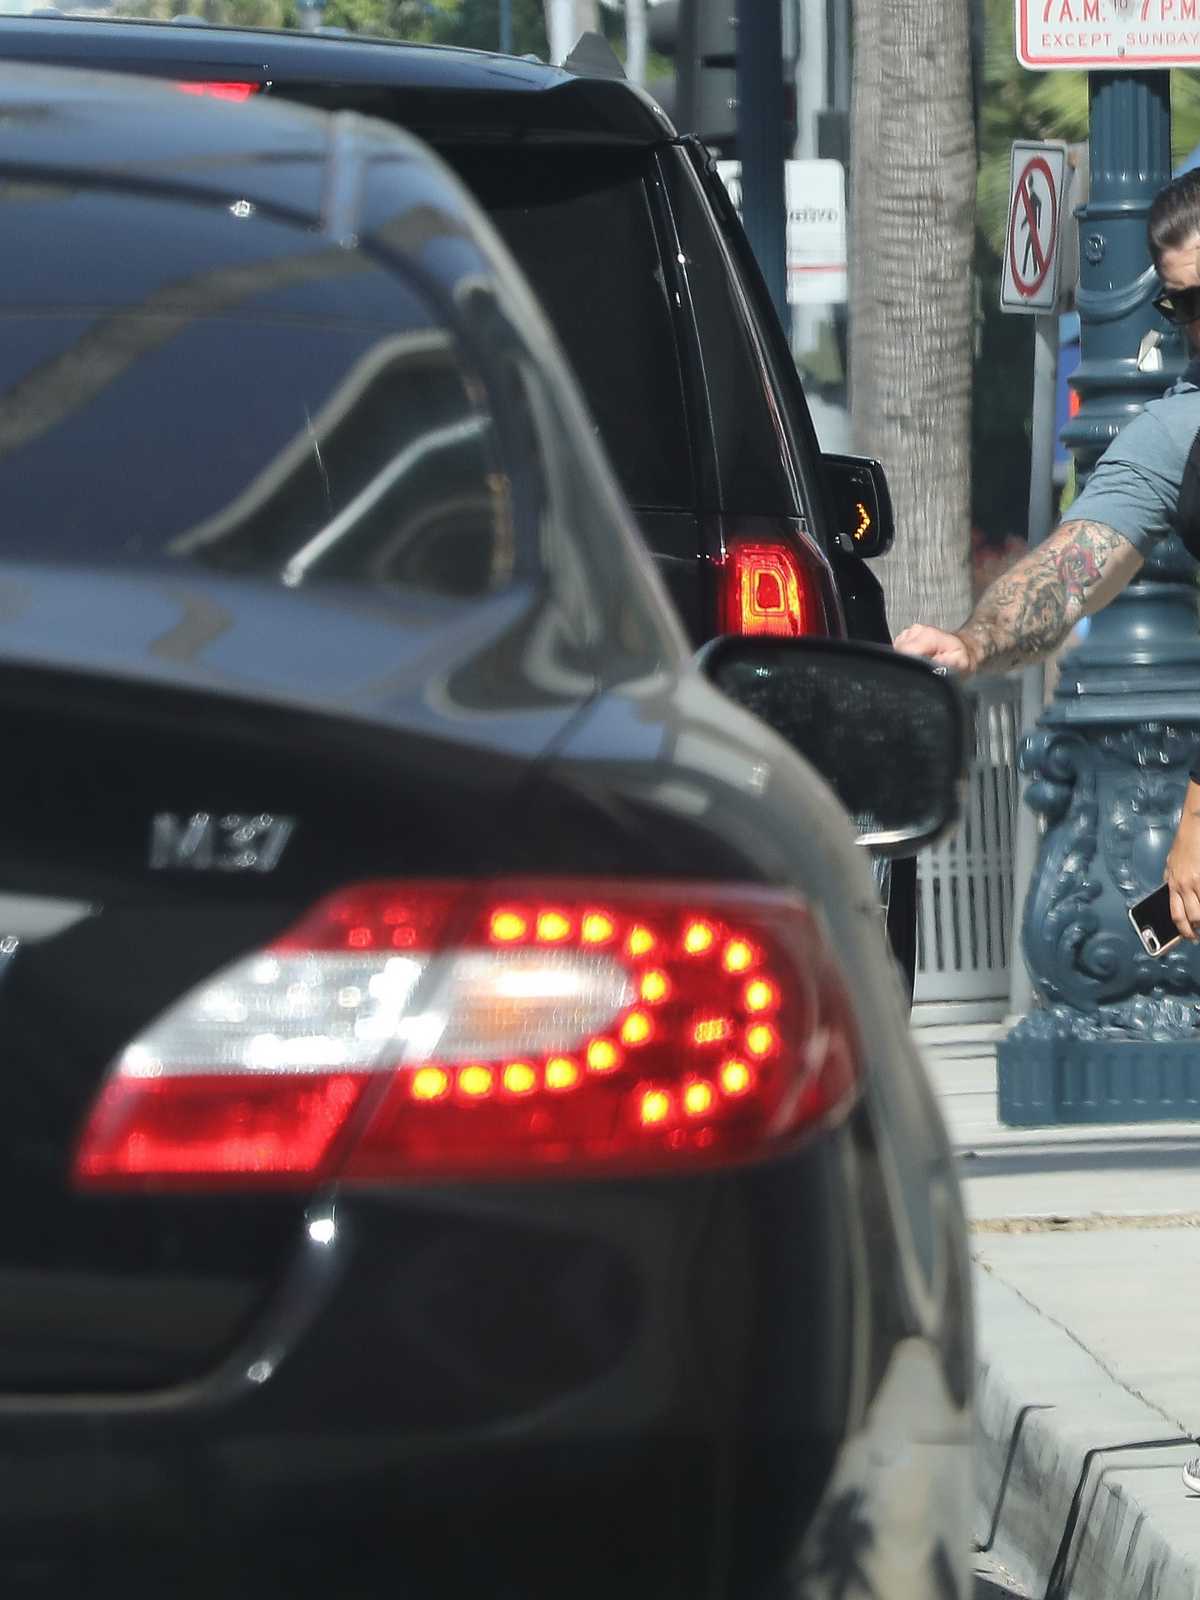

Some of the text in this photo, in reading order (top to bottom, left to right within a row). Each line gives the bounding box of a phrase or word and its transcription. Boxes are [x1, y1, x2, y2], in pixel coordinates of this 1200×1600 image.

[1042, 32, 1200, 47] EXCEPT SUNDAY
[150, 812, 295, 873] M37
